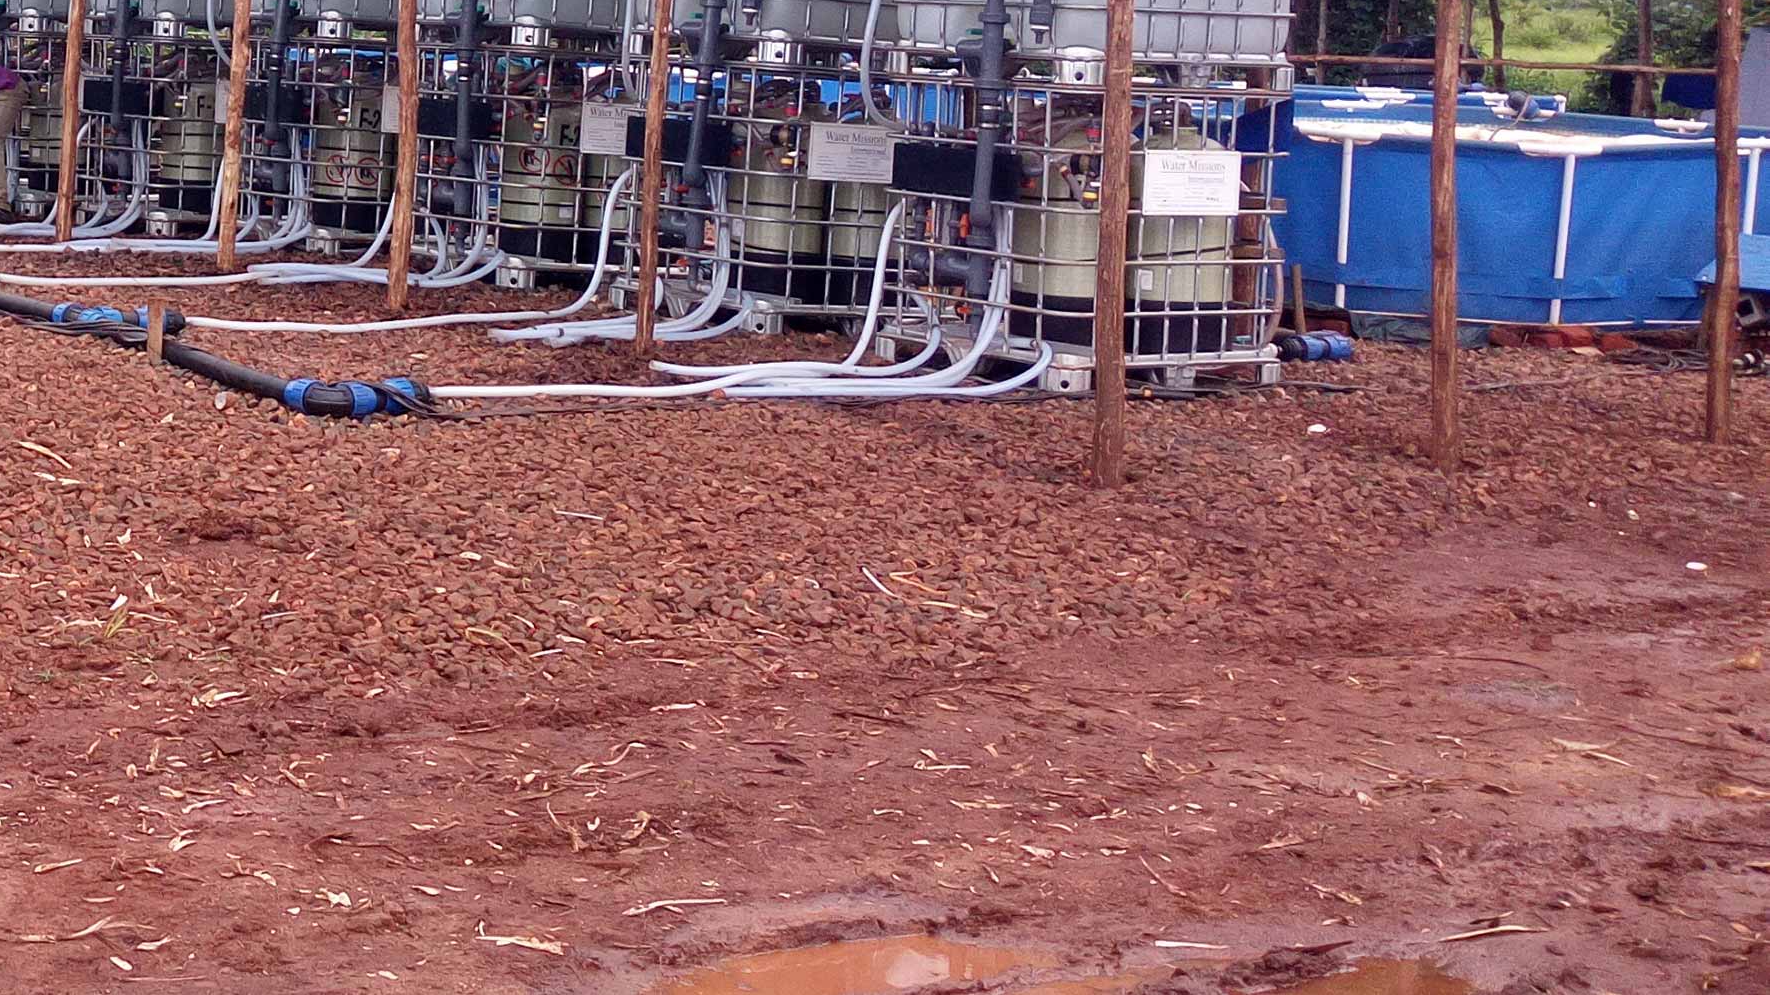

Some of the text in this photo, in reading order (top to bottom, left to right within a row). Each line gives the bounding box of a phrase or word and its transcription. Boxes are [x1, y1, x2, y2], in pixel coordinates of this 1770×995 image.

[590, 107, 613, 118] Water
[826, 131, 849, 142] Water
[1161, 159, 1186, 171] Water
